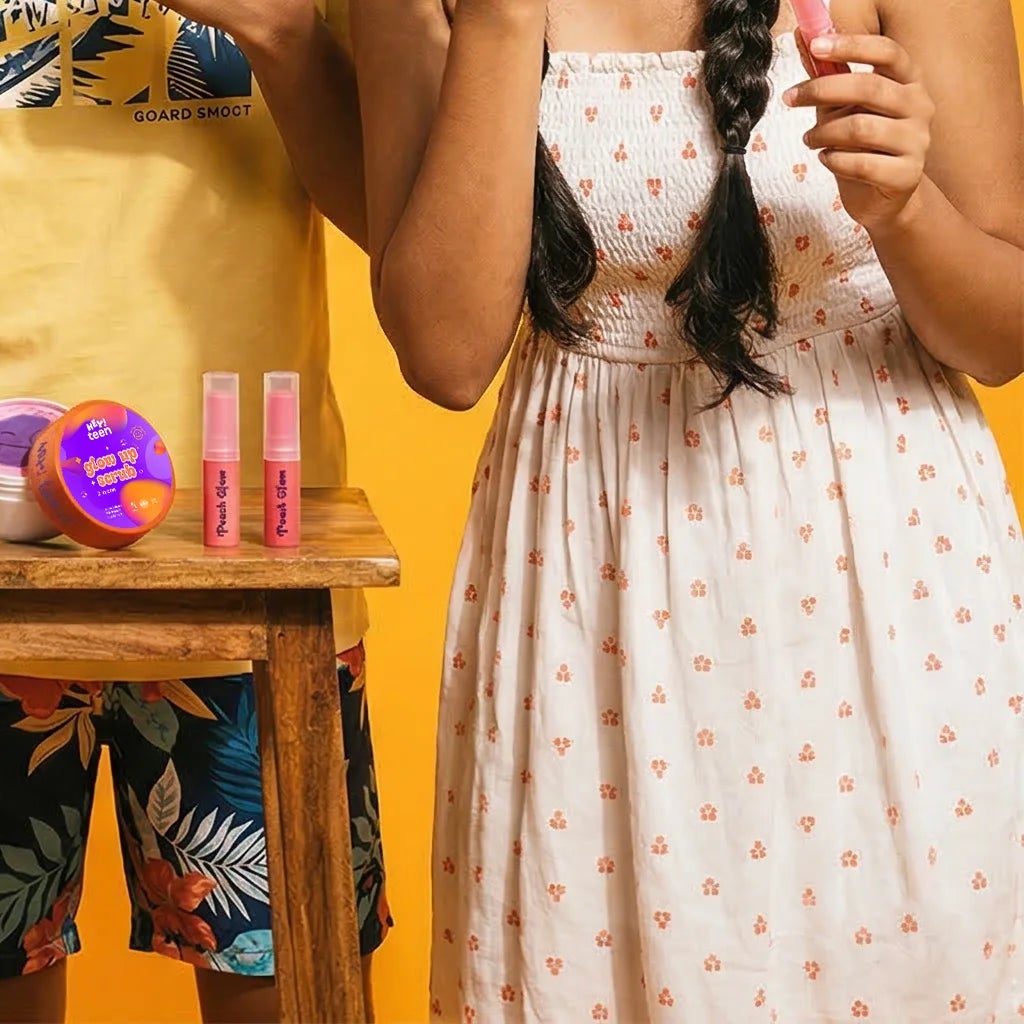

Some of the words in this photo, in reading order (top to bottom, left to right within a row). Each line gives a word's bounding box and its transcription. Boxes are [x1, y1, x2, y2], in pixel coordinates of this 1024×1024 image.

[134, 107, 192, 123] GOARD
[86, 418, 107, 432] HEY!
[87, 426, 113, 441] teen
[84, 454, 116, 478] glow
[118, 447, 139, 464] up
[97, 463, 137, 487] scrub
